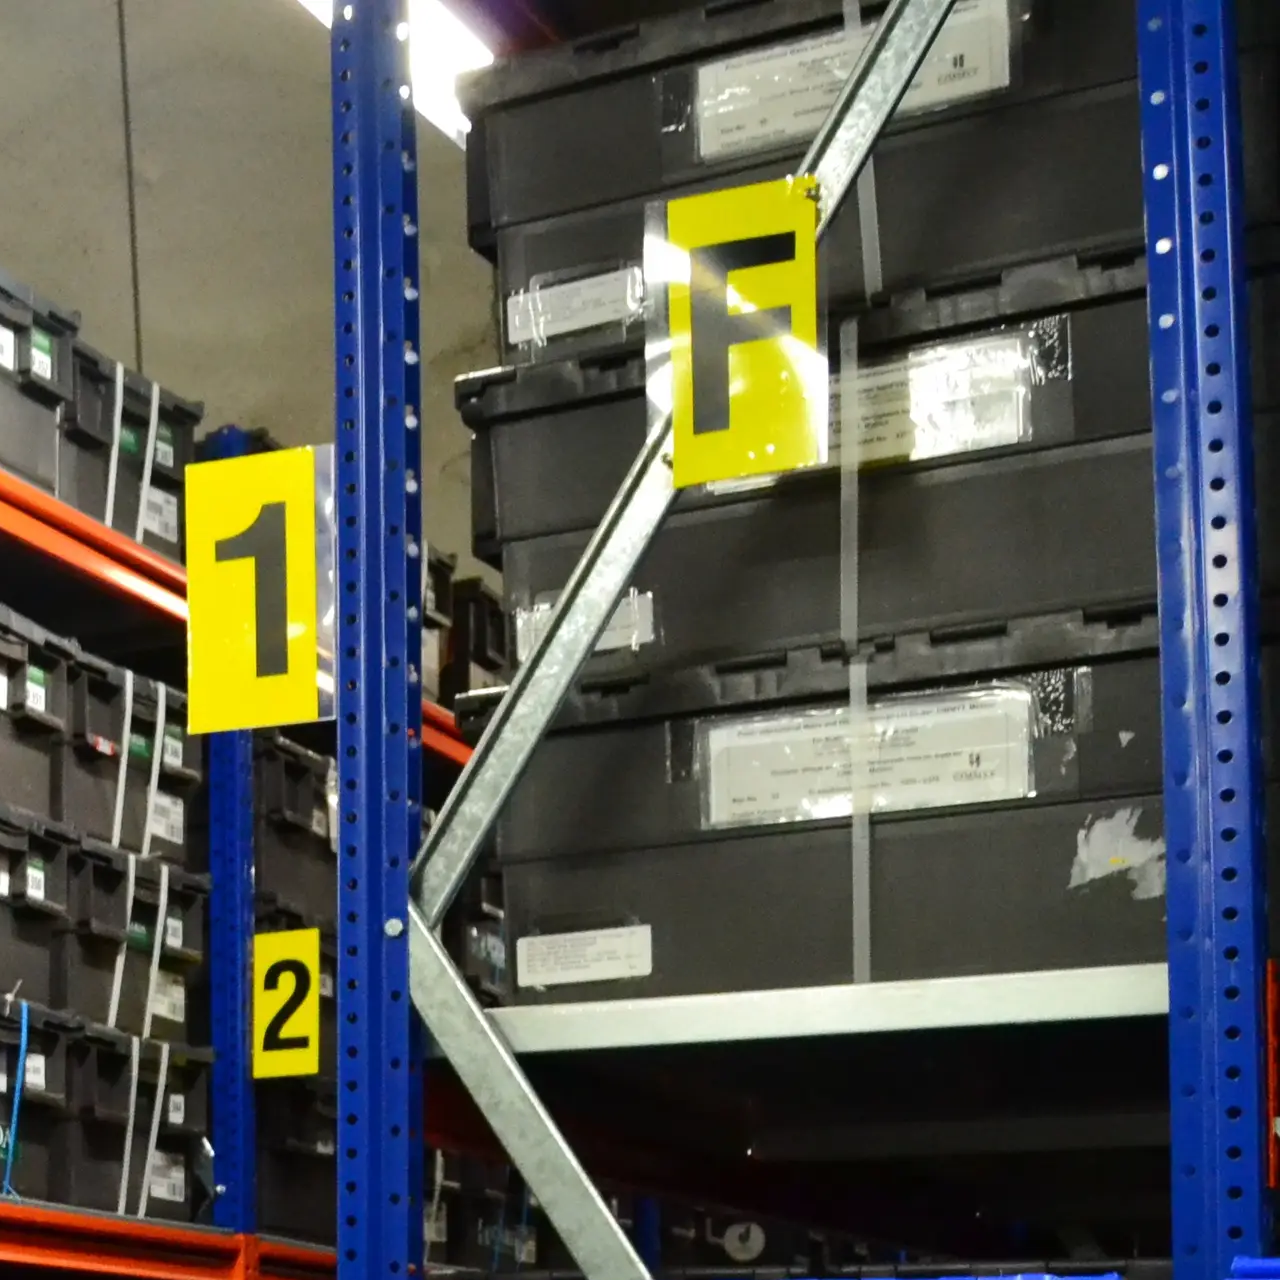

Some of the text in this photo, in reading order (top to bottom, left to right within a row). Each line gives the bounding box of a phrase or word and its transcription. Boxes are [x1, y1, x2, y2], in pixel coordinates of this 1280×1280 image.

[690, 229, 797, 435] F
[215, 500, 289, 678] 1
[262, 958, 311, 1053] 2
